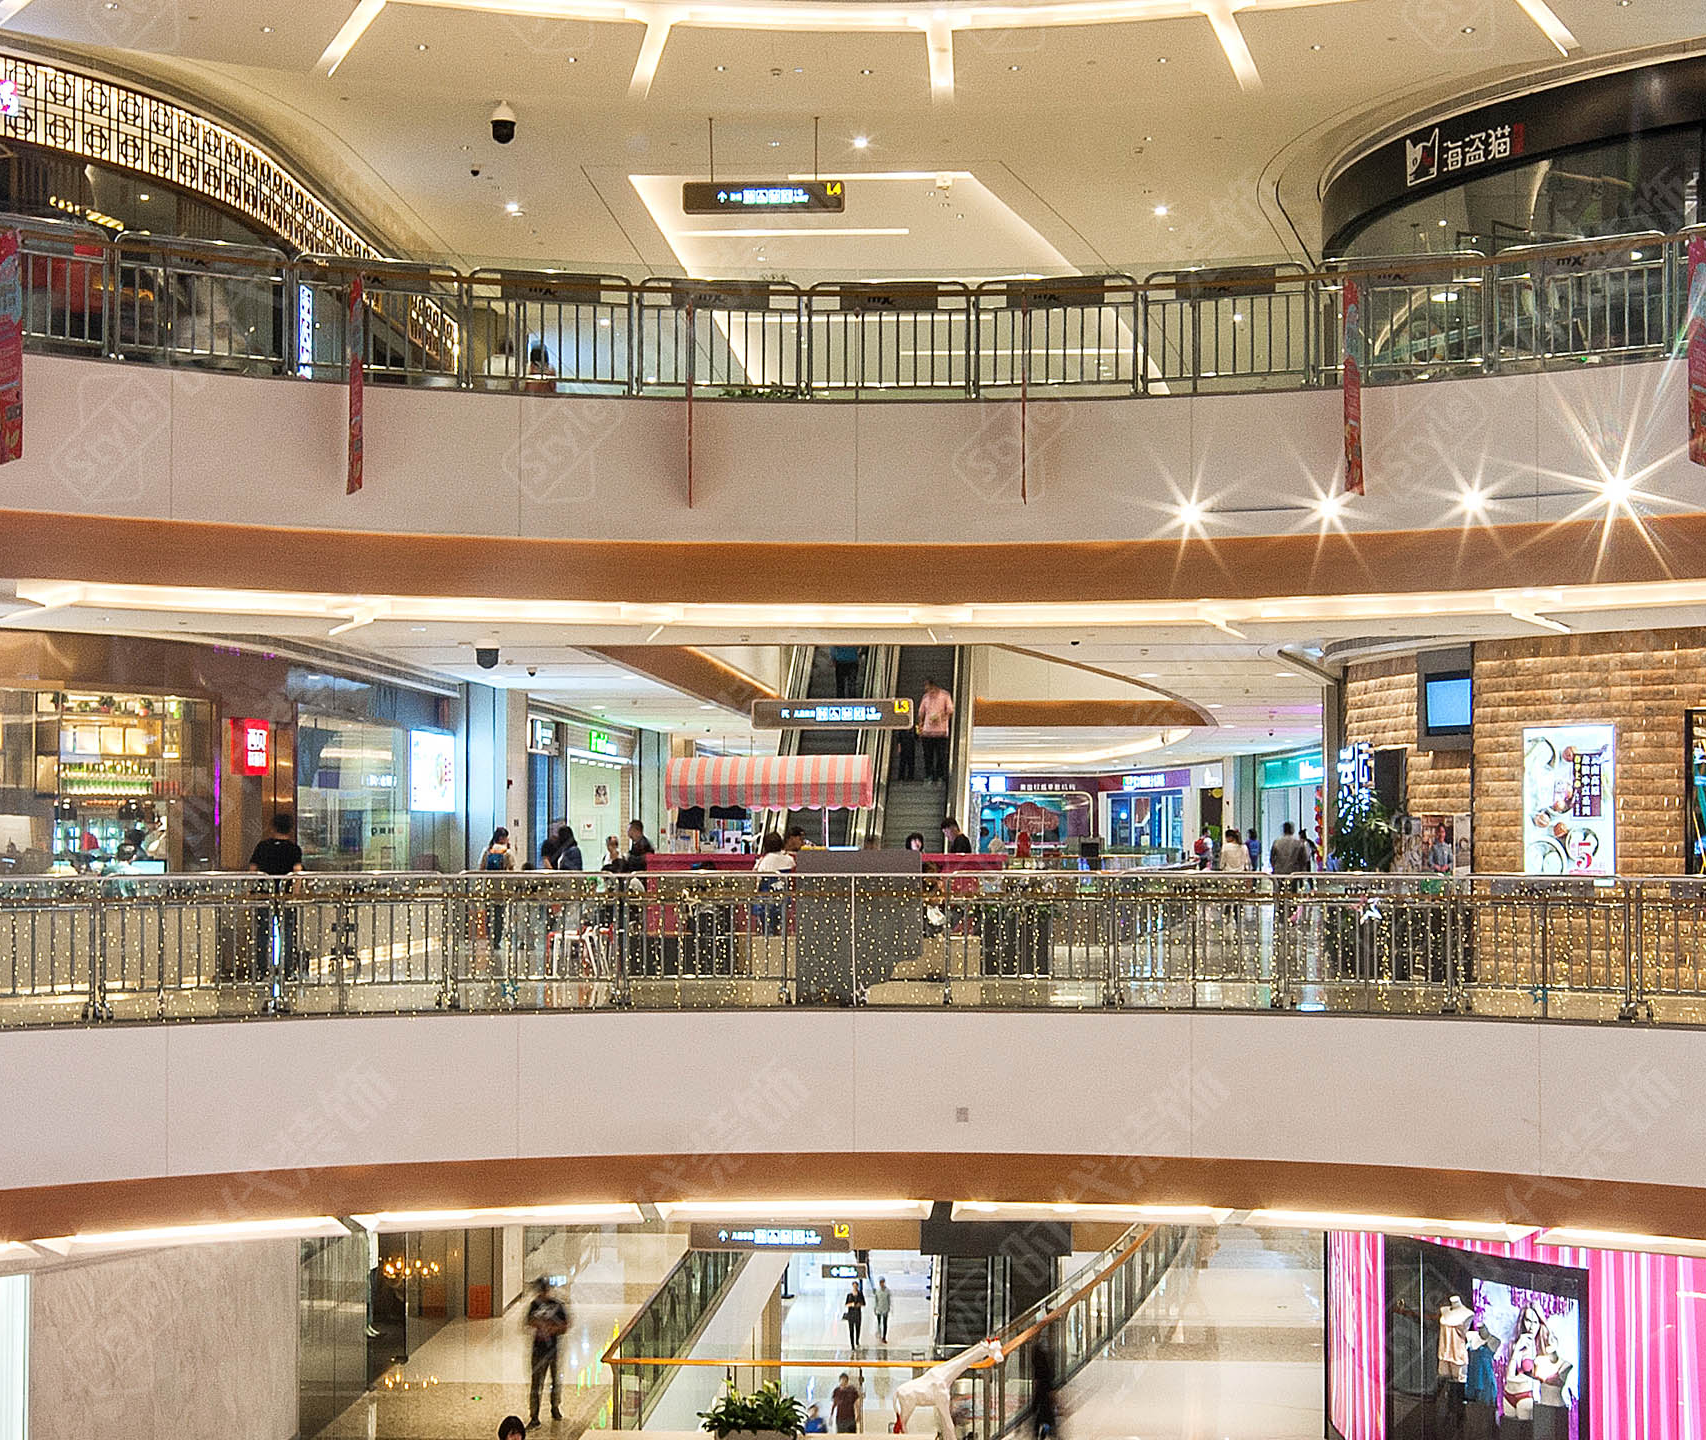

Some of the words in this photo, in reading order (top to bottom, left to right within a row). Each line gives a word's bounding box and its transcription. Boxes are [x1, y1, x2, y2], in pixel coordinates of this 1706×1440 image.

[1443, 124, 1512, 172] 海盗猫
[826, 182, 842, 195] L4
[894, 700, 910, 713] L3
[833, 1223, 850, 1238] L2
